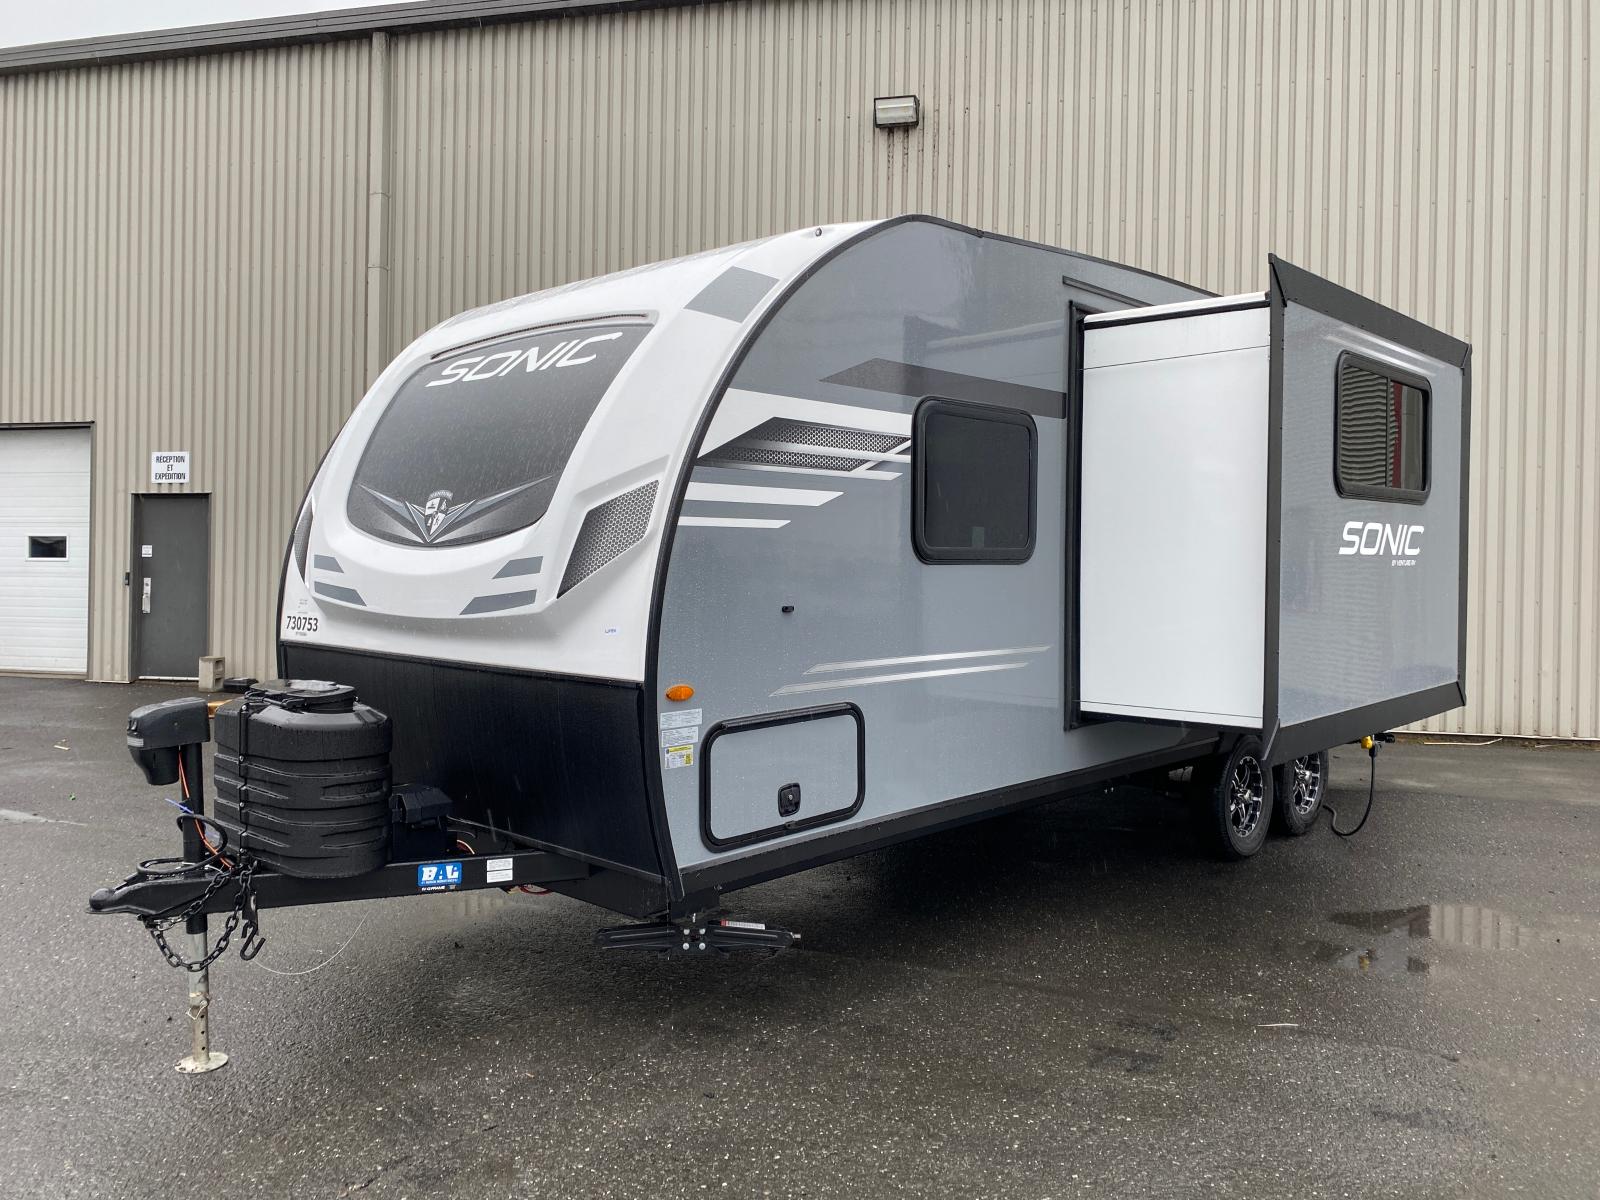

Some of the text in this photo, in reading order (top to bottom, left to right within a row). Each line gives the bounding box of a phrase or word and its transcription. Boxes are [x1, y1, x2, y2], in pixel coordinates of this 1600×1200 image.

[425, 332, 623, 387] SONIC
[1338, 521, 1425, 555] SONIC
[286, 615, 319, 632] 730753
